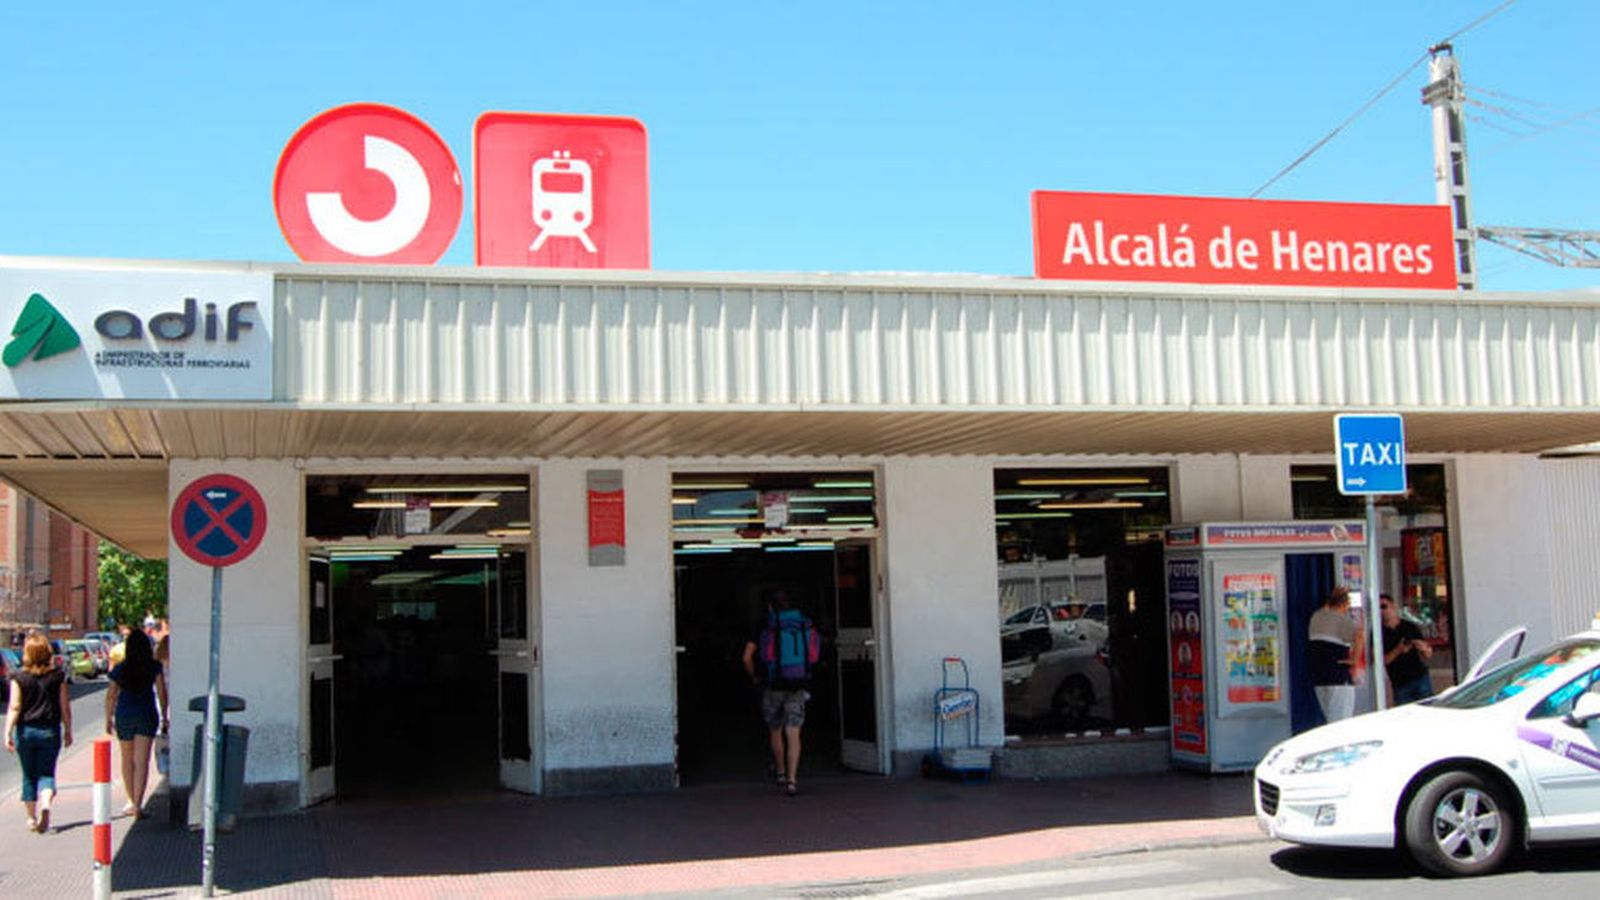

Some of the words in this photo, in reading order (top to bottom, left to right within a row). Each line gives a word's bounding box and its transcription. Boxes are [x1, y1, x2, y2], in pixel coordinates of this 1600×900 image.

[1062, 220, 1196, 268] Alcalá
[1208, 226, 1259, 270] de
[1271, 230, 1433, 275] Henares
[94, 297, 258, 342] adif
[1343, 442, 1401, 466] TAXI
[1168, 563, 1201, 578] FOTOS
